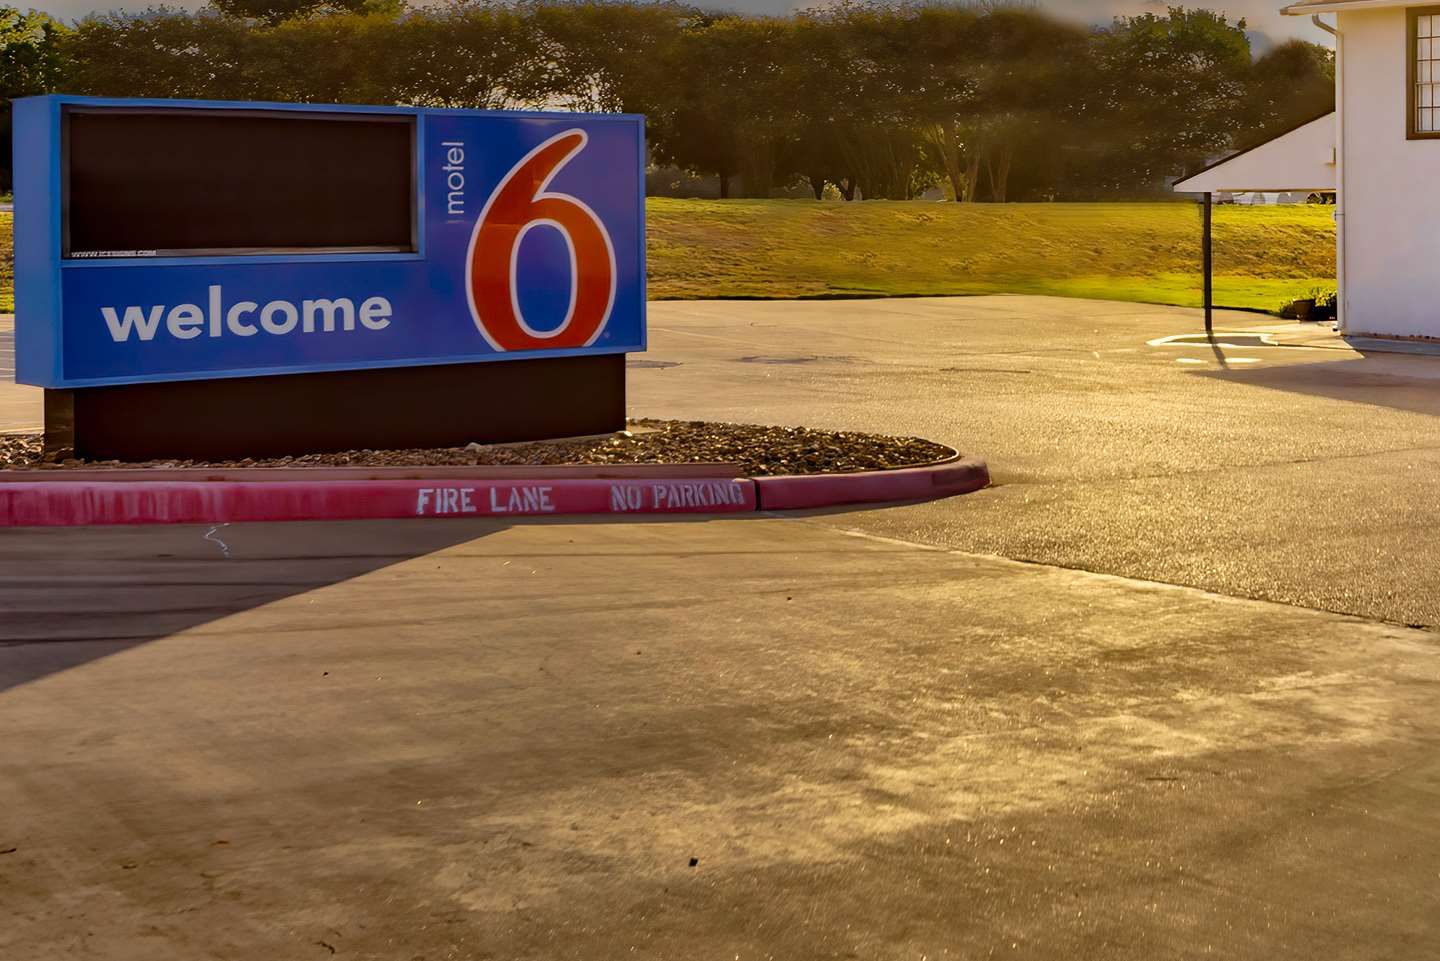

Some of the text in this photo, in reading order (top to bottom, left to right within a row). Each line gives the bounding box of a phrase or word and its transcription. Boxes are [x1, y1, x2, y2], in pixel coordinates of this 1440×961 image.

[441, 127, 617, 352] motel 6
[101, 285, 393, 342] welcome
[416, 483, 746, 515] FIRE LANE NO PARKING
